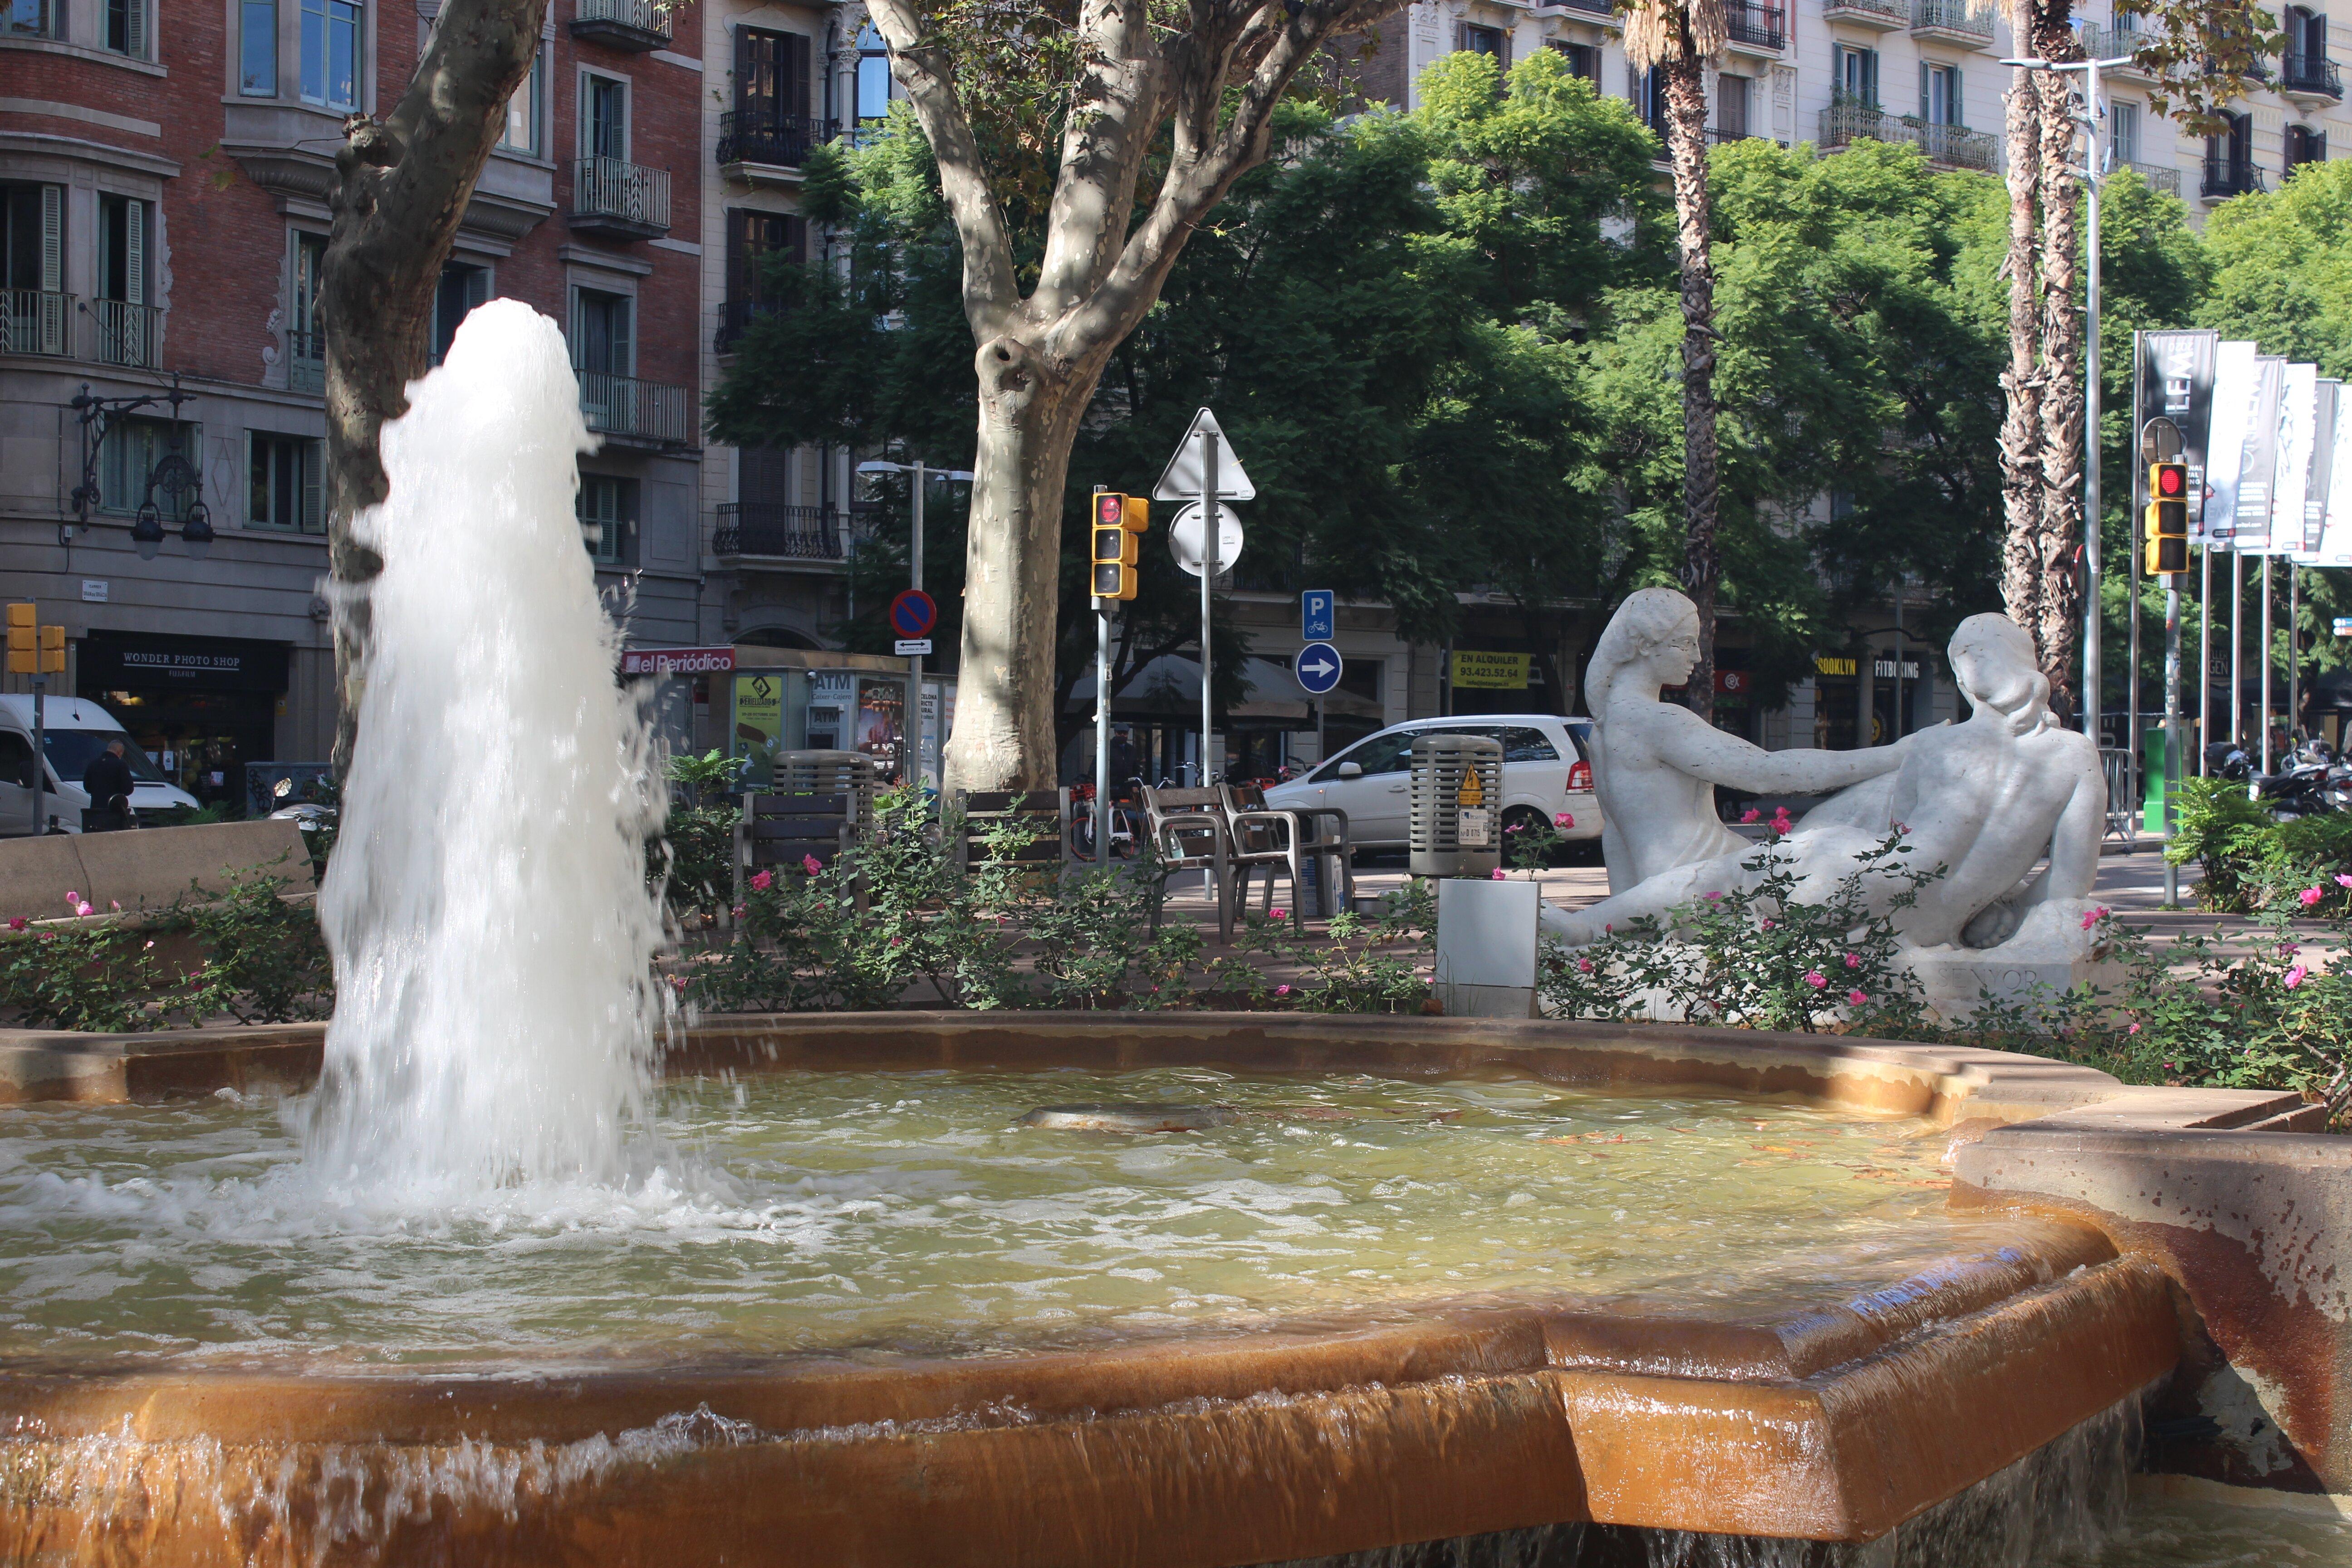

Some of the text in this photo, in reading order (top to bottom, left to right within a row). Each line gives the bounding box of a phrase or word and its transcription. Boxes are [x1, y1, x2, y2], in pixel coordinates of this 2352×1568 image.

[1311, 598, 1324, 616] P
[123, 652, 240, 666] WONDER PHOTO SHOP
[640, 653, 731, 672] el Periódico
[1461, 654, 1519, 665] EN ALQUILER
[1460, 667, 1518, 677] 93.423.52.64
[814, 674, 850, 690] ATM
[814, 711, 839, 722] ATM
[1936, 968, 2037, 990] SENYOR
